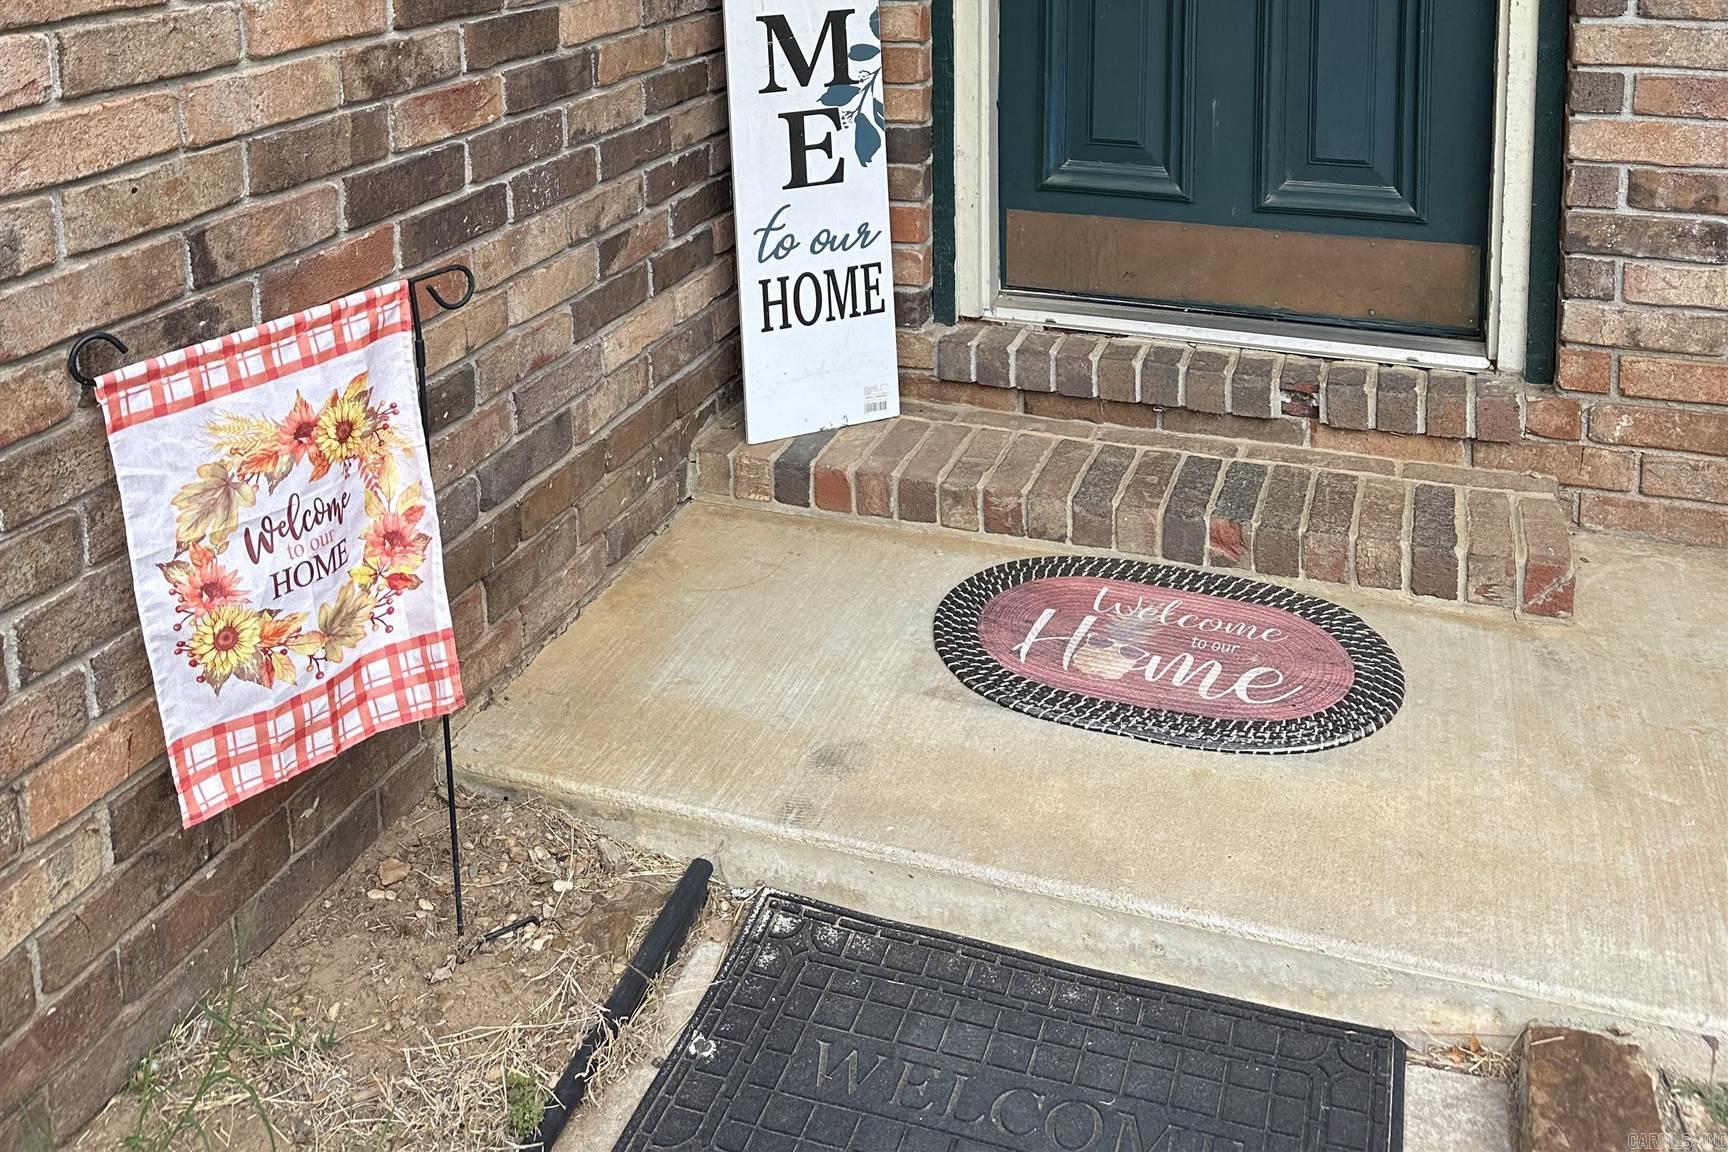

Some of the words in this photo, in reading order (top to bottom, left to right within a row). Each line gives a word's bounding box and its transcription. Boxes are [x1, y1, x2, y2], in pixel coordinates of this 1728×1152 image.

[753, 203, 801, 264] to
[809, 221, 883, 256] our
[758, 261, 886, 333] HOME
[243, 492, 352, 565] Welcome
[287, 543, 305, 561] to
[310, 528, 336, 552] our
[269, 537, 350, 601] HOME
[1092, 586, 1290, 643] Welcome
[1191, 635, 1208, 650] to
[1211, 640, 1242, 655] our
